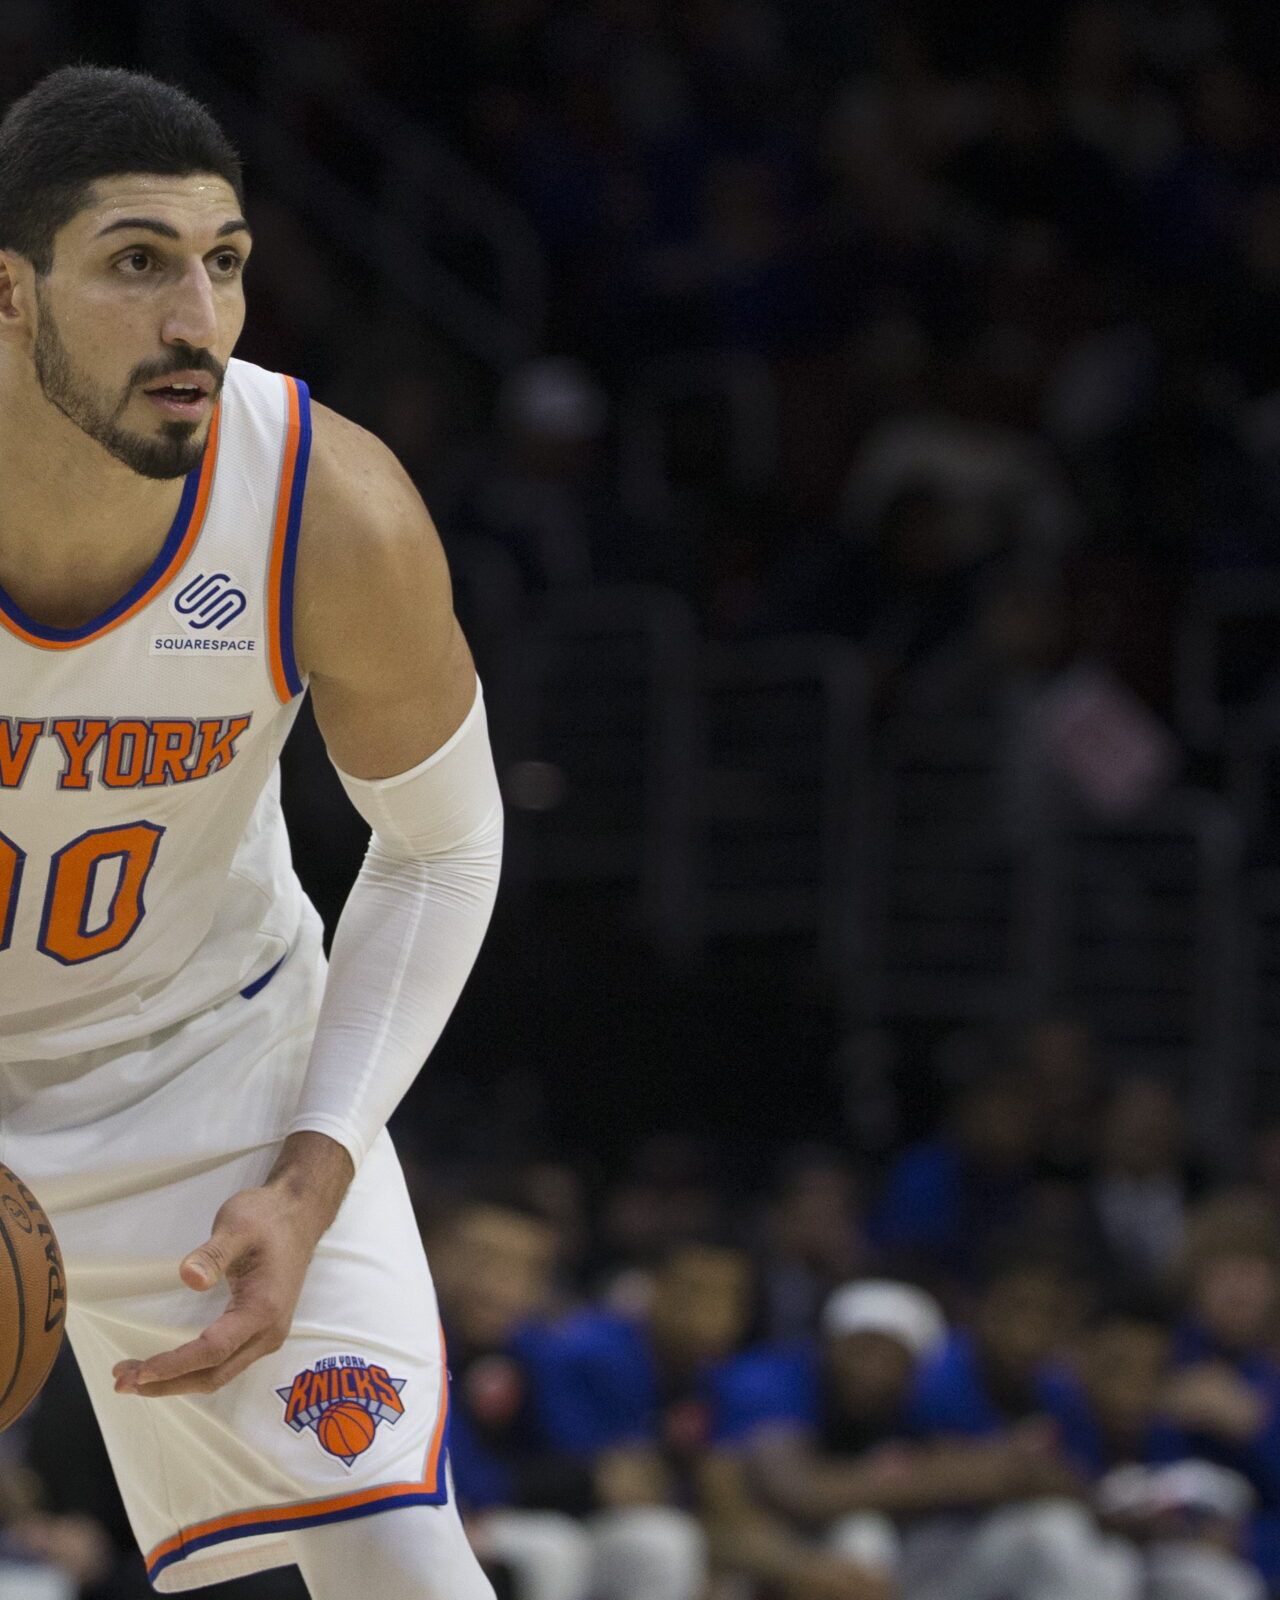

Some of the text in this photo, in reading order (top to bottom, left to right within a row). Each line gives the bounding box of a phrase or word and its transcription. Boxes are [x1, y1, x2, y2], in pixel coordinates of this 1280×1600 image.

[154, 638, 255, 651] SQUARESPACE
[47, 710, 254, 792] YORK
[314, 1355, 366, 1371] NEW YORK
[284, 1364, 405, 1425] KNICKS
